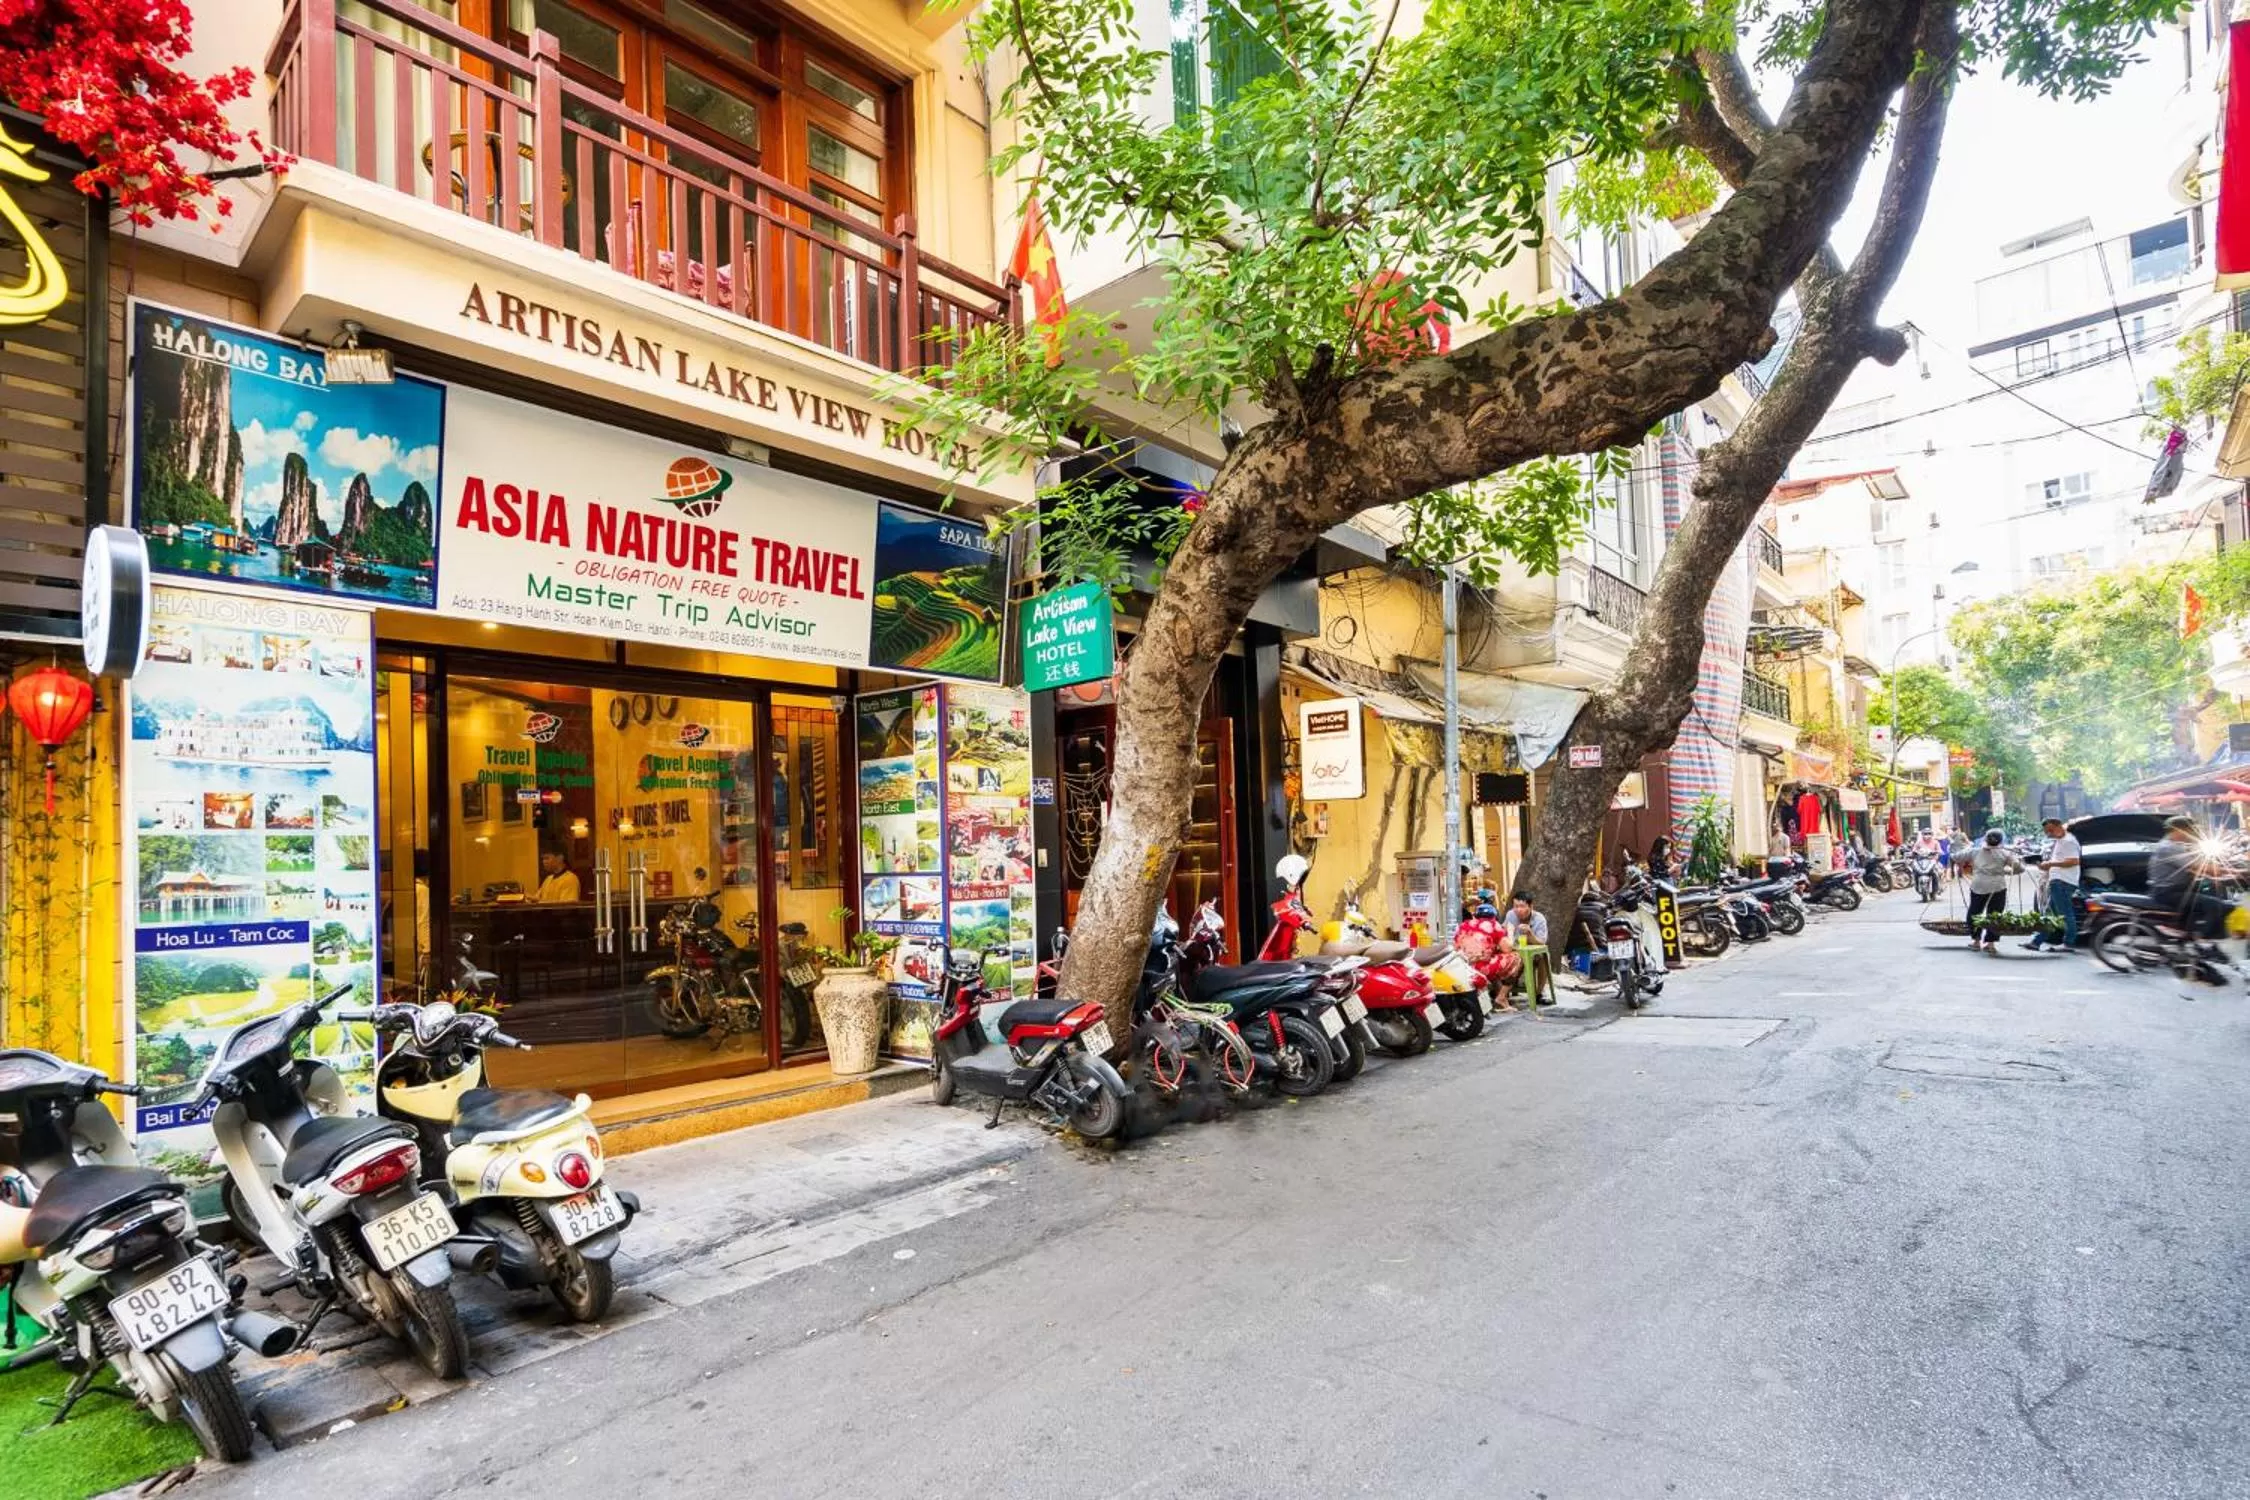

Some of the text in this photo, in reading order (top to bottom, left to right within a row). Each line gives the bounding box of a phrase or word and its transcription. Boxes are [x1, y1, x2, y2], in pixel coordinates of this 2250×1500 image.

[153, 323, 270, 372] HALONG
[459, 282, 979, 474] ARTISAN LAKE VIEW HOTEL
[456, 475, 865, 601] ASIA NATURE TRAVEL
[939, 525, 972, 547] SAPA
[575, 559, 684, 592] OBLIGATION
[691, 579, 730, 599] FREE
[737, 586, 788, 608] QUOTE
[152, 592, 351, 637] HALONG BAY
[480, 598, 494, 613] 23
[496, 602, 522, 619] Hang
[526, 605, 551, 620] Hanh
[527, 573, 817, 637] Master Trip Advisor
[1033, 594, 1088, 624] Artisan
[1027, 615, 1096, 649] Lake View
[1036, 641, 1087, 664] HOTEL
[485, 745, 531, 767] Travel
[156, 932, 189, 947] Hoa
[194, 930, 215, 945] Lu
[229, 929, 263, 943] Tam
[266, 926, 295, 941] Coc
[1659, 897, 1677, 957] FOOT
[145, 1109, 174, 1128] Bai
[377, 1201, 434, 1240] 36-K5
[383, 1218, 450, 1262] 110.09
[570, 1206, 616, 1238] 8228
[128, 1267, 201, 1317] 90-B2
[135, 1284, 224, 1344] 482.42
